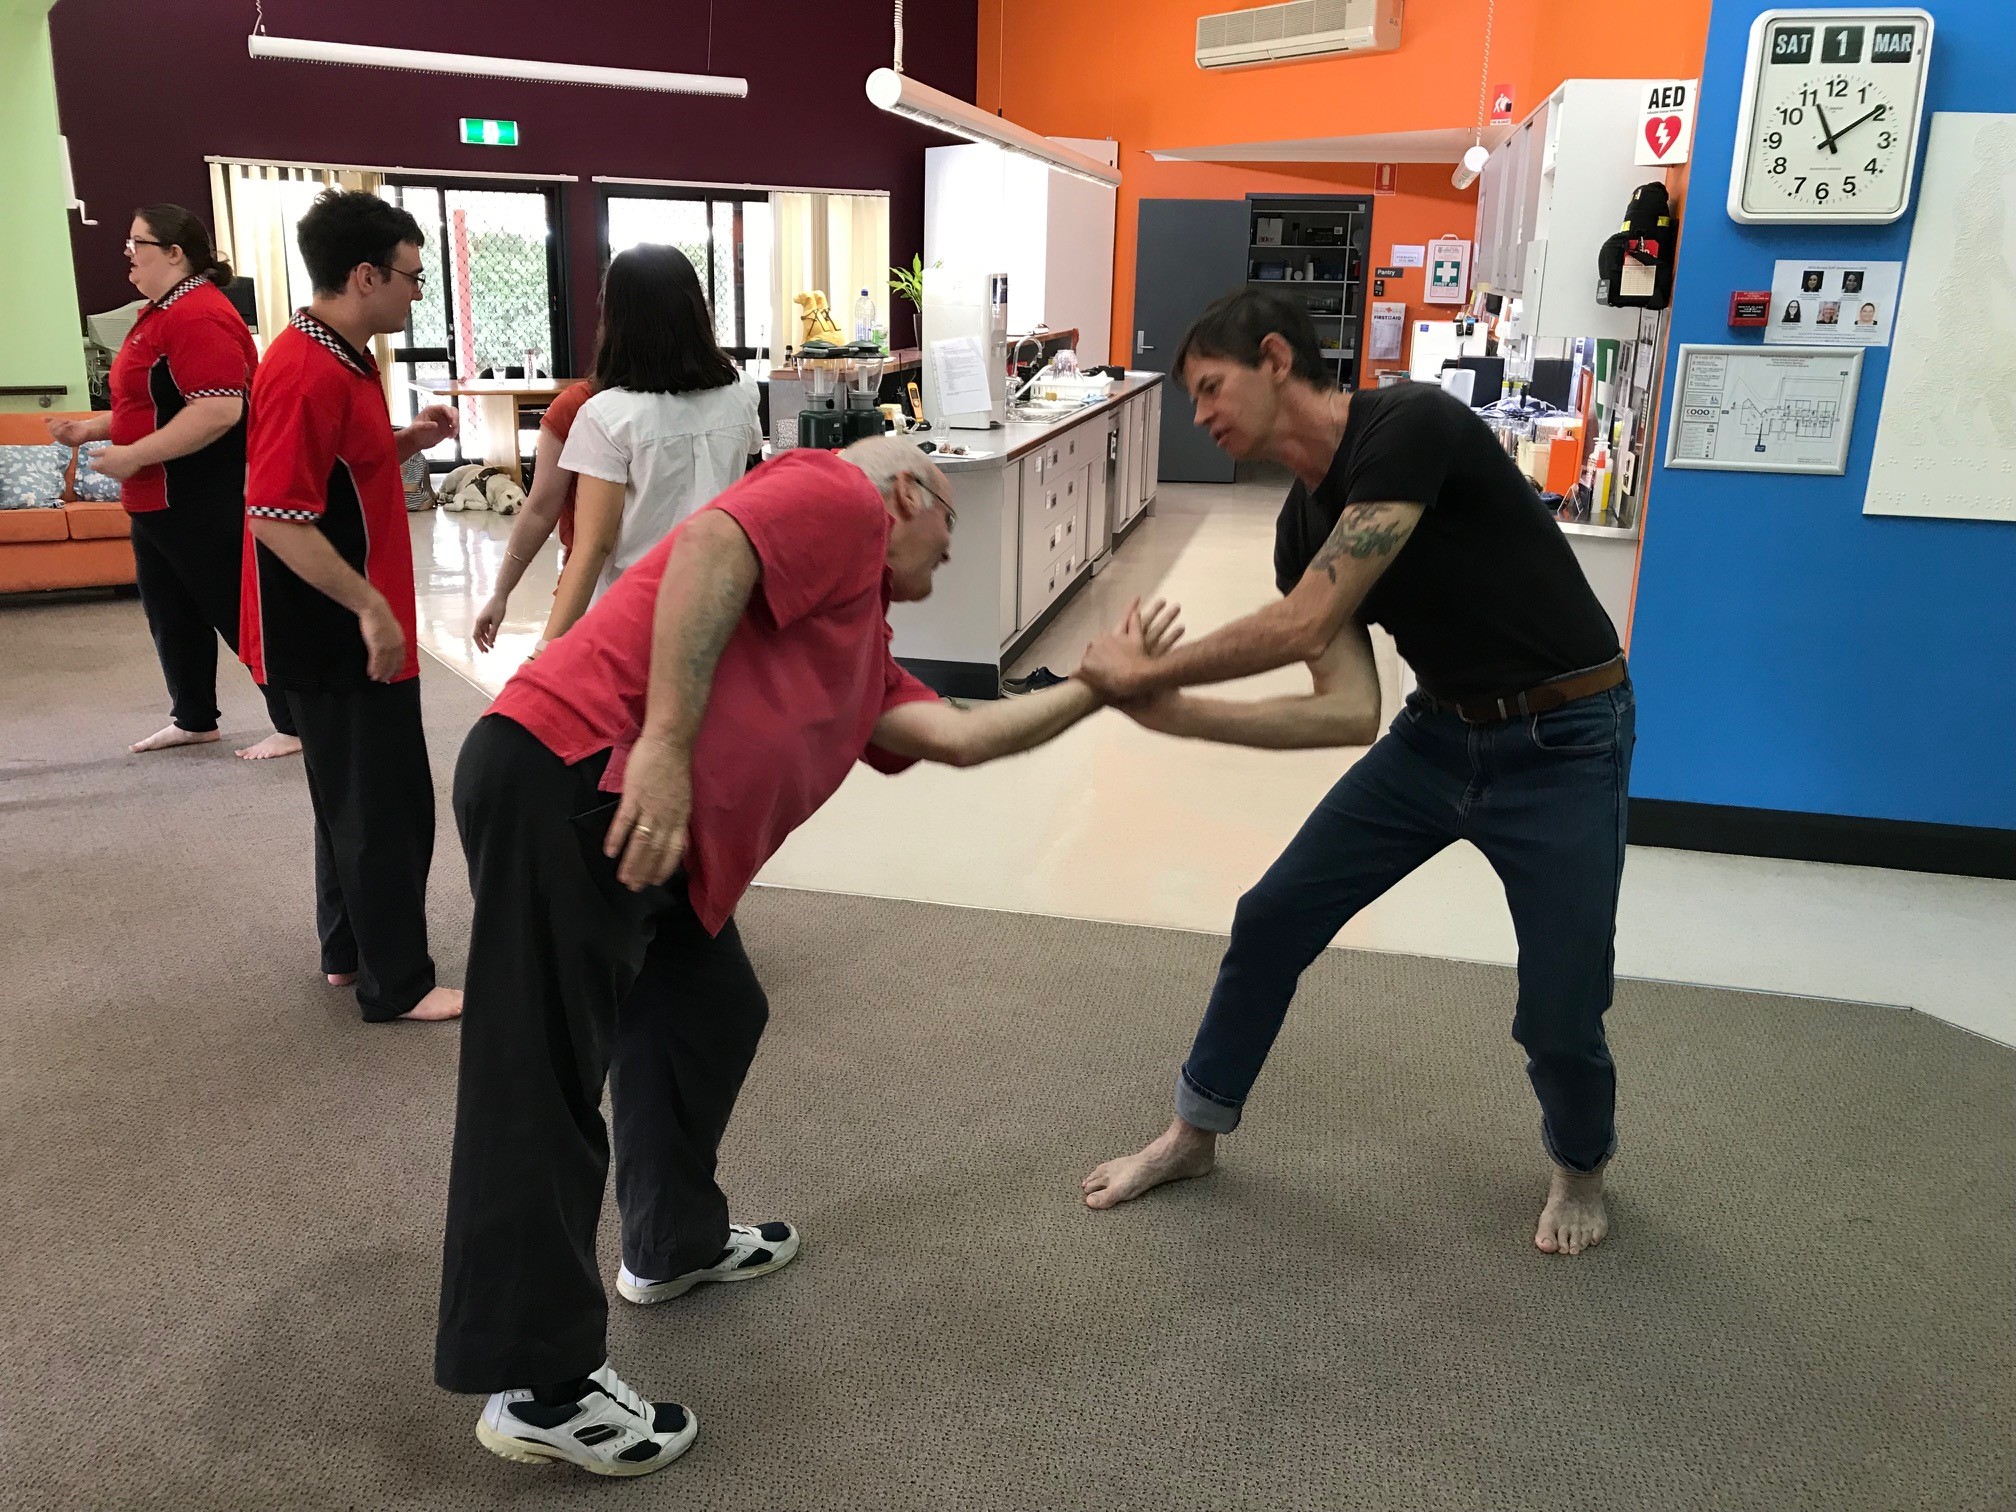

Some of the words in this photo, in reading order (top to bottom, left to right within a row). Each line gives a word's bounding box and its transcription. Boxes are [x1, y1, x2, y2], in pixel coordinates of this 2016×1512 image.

[1775, 34, 1811, 54] SAT
[1836, 30, 1848, 57] 1
[1874, 33, 1912, 53] MAR
[1825, 79, 1849, 97] 12
[1857, 86, 1867, 104] 1
[1648, 86, 1686, 110] AED
[1799, 89, 1818, 107] 11
[1779, 107, 1804, 125] 10
[1872, 104, 1887, 121] 2
[1768, 132, 1783, 149] 9
[1877, 131, 1892, 149] 3
[1773, 157, 1787, 174] 8
[1864, 157, 1878, 175] 4
[1794, 176, 1807, 194] 7
[1815, 182, 1829, 200] 6
[1842, 176, 1856, 193] 5
[1377, 269, 1396, 277] Pantry
